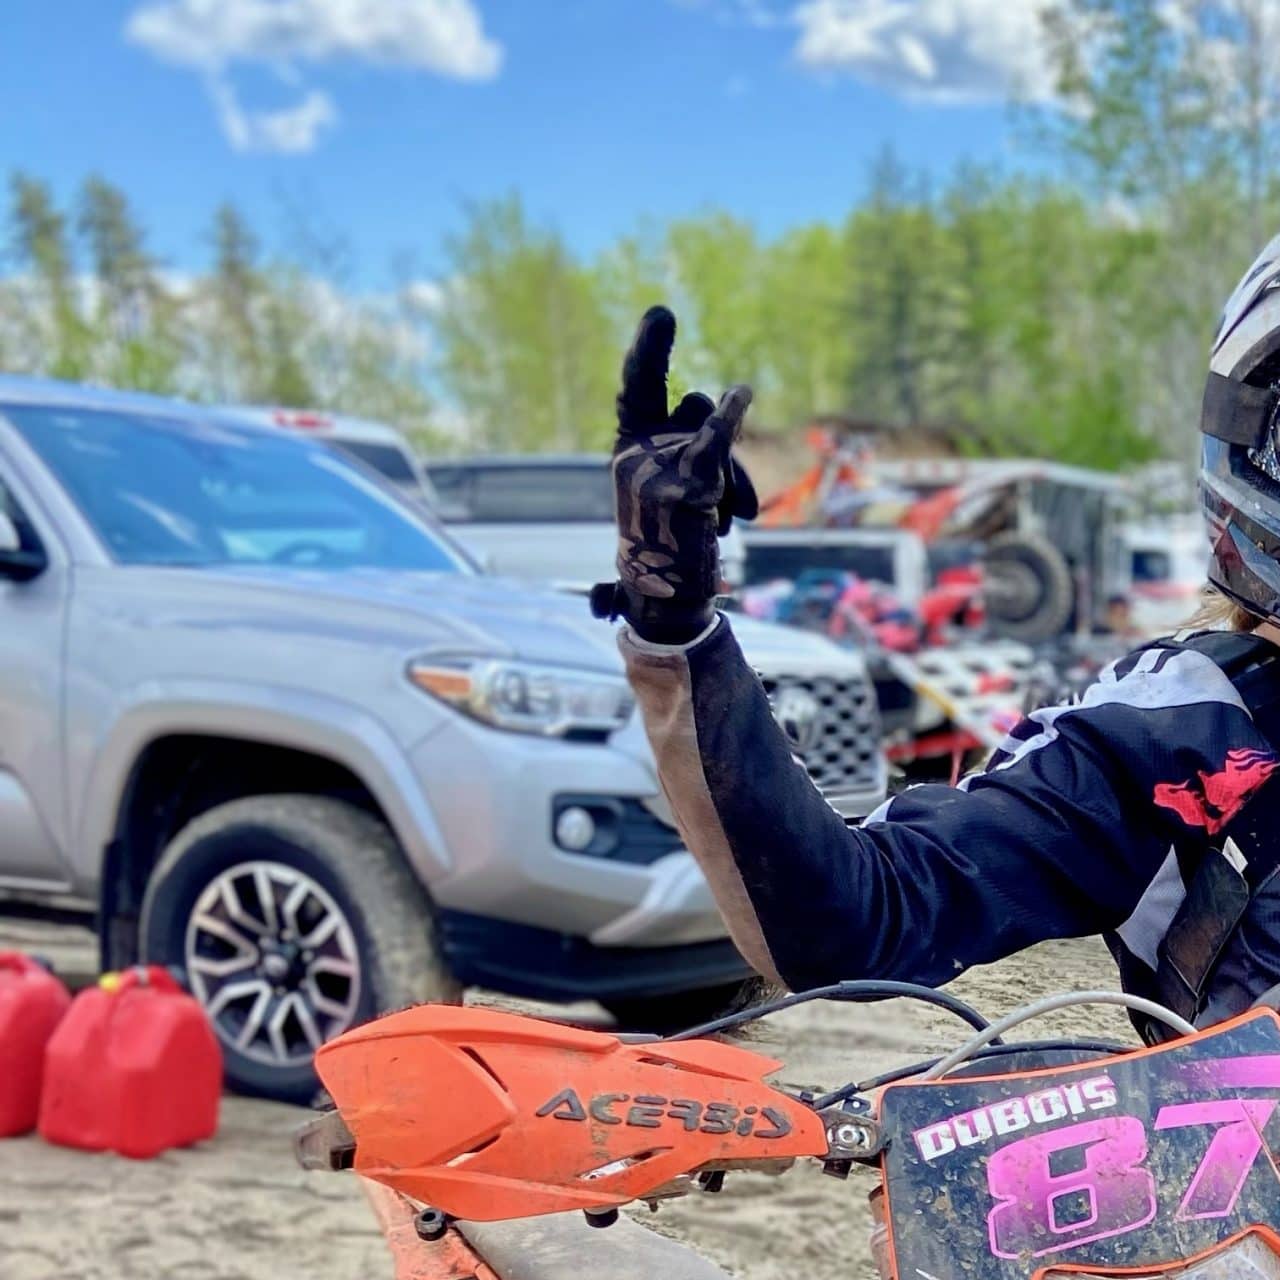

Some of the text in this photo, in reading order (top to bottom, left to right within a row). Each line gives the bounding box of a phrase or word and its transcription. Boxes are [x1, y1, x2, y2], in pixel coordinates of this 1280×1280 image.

[535, 1087, 792, 1139] ACERBIS
[913, 1075, 1118, 1163] DUBOIS
[987, 1099, 1280, 1260] 87
